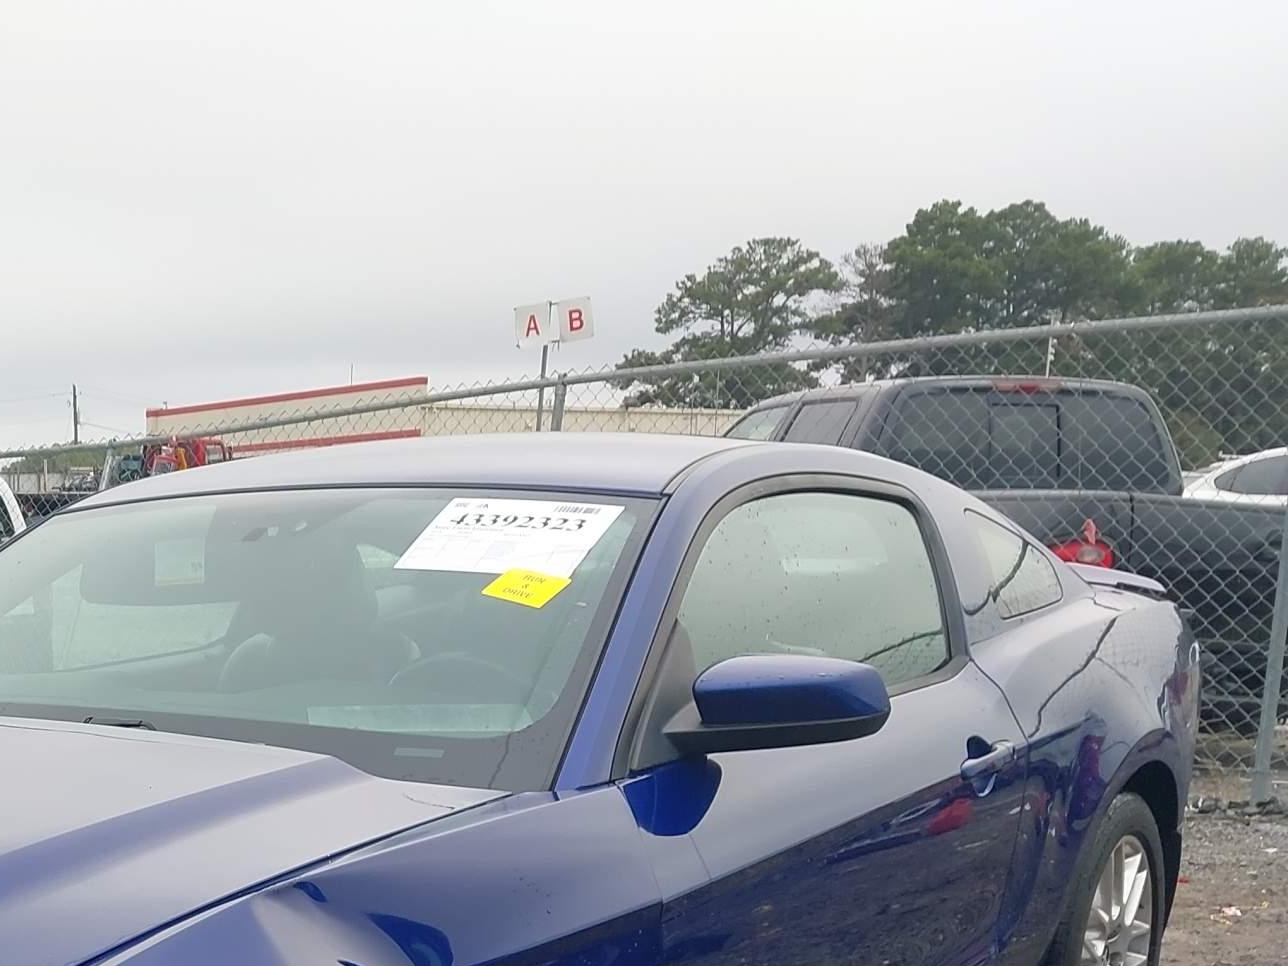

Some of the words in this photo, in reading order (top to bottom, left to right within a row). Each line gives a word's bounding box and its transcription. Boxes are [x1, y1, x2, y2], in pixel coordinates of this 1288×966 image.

[526, 314, 540, 338] A
[569, 308, 584, 332] B
[450, 513, 587, 531] 43392323
